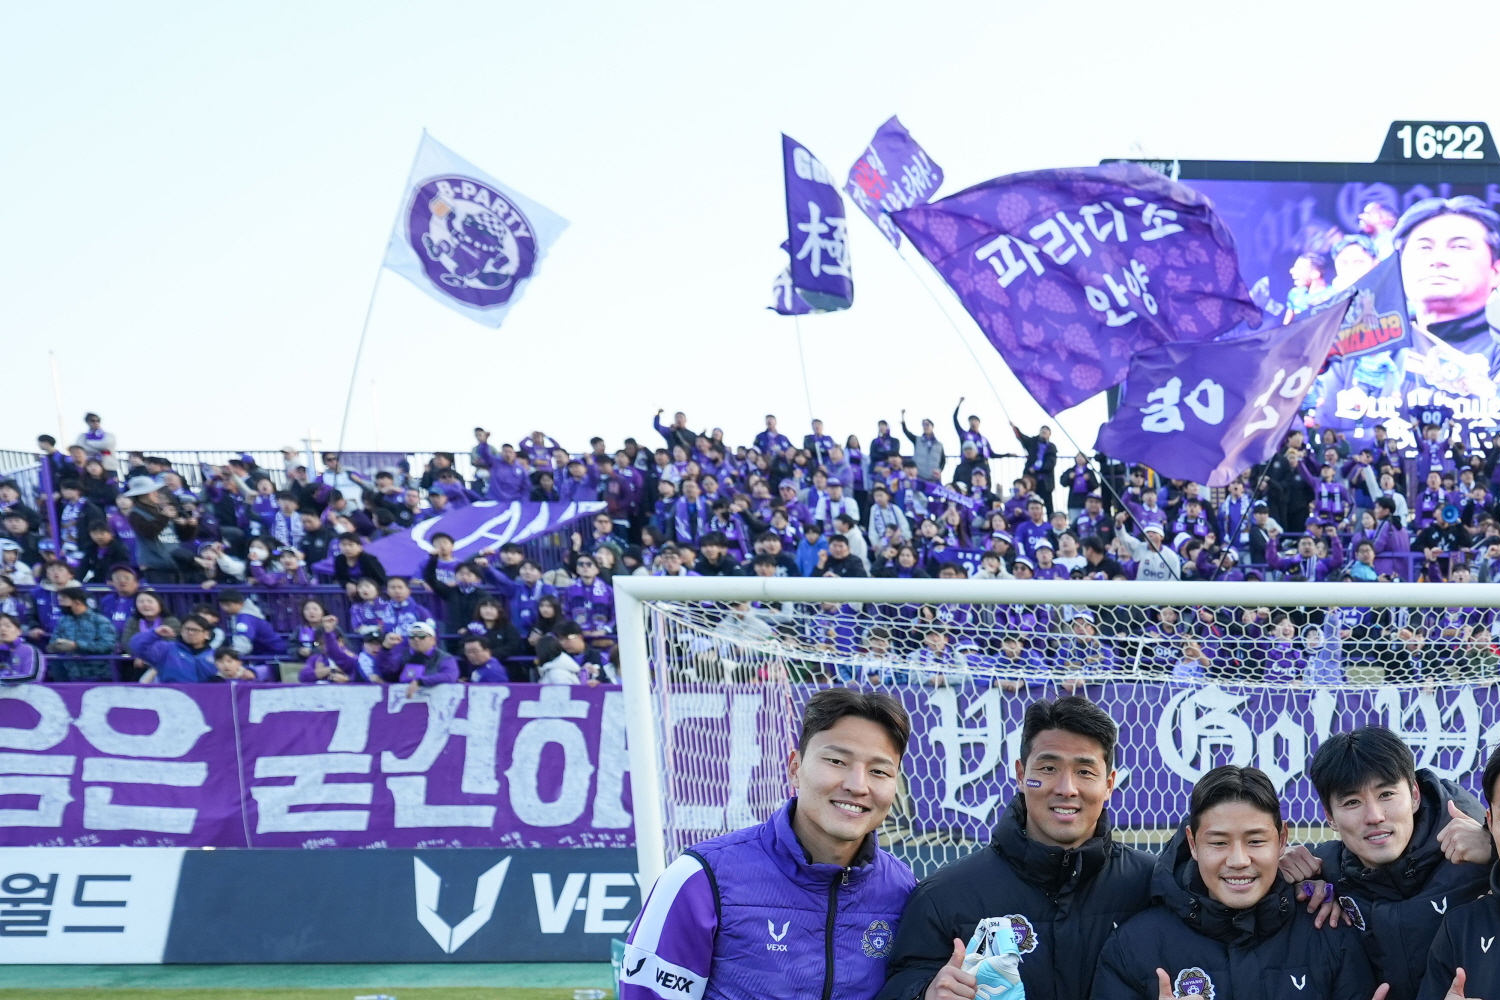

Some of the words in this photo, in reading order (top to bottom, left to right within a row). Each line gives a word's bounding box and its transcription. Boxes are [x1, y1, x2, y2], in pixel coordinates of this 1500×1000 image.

[1397, 126, 1484, 160] 16:22
[435, 180, 531, 238] B-PARTY
[975, 197, 1185, 288] 파라디소
[1084, 258, 1158, 327] 안양
[532, 872, 640, 934] VE
[766, 943, 788, 952] VEXX
[656, 967, 695, 994] VEXX
[1181, 979, 1203, 987] ANYANG
